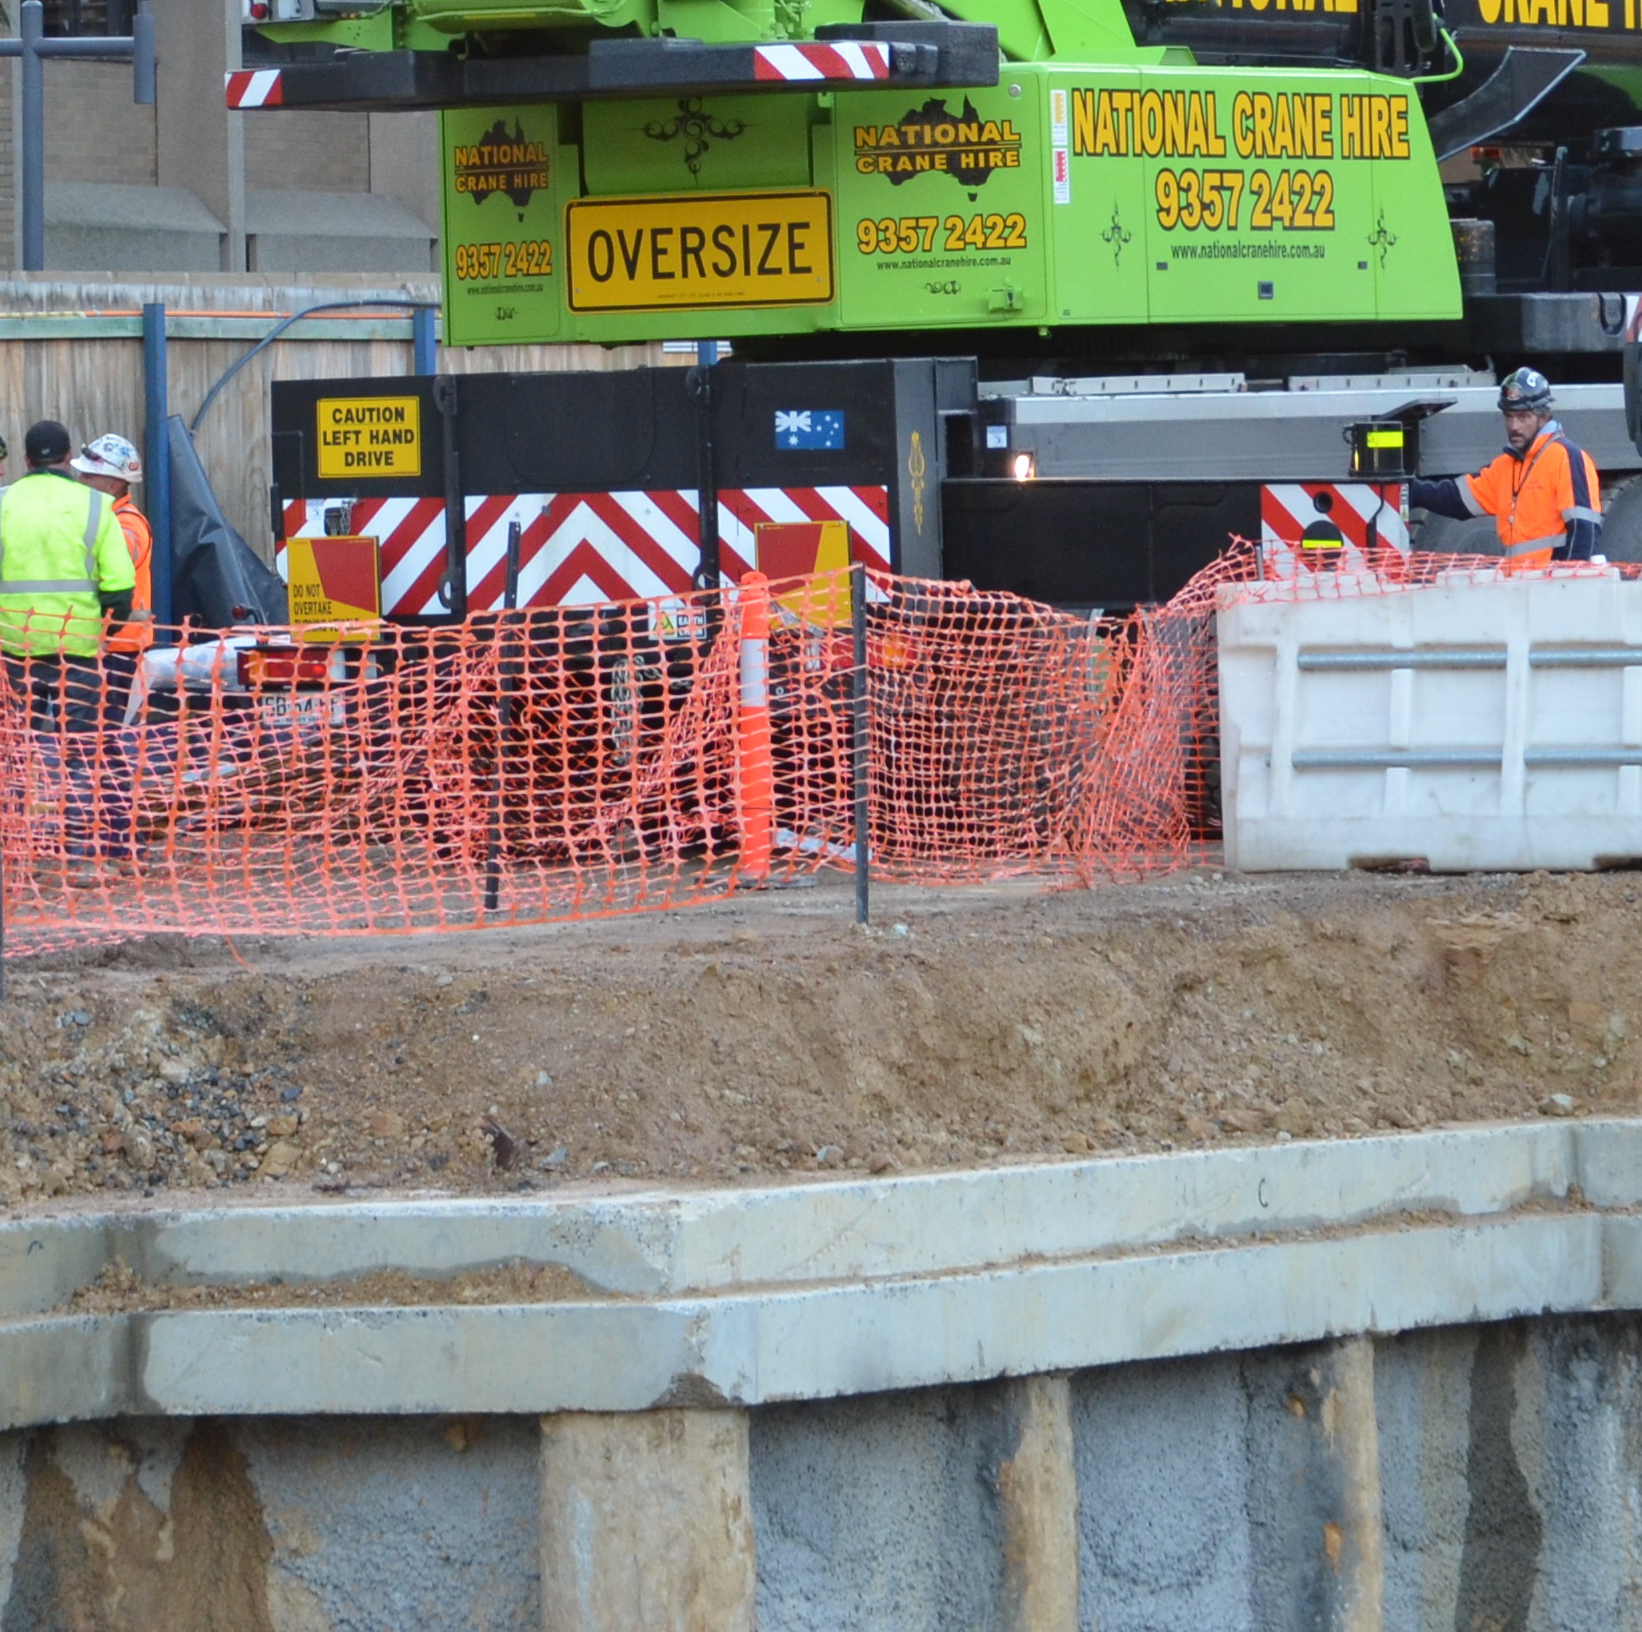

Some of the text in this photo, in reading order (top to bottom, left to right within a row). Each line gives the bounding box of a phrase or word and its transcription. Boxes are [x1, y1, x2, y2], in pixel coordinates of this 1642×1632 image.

[854, 120, 1021, 148] NATIONAL
[1072, 88, 1226, 157] NATIONAL
[1233, 91, 1333, 159] CRANE
[1340, 93, 1410, 159] HIRE
[455, 142, 549, 167] NATIONAL
[856, 149, 1020, 174] CRANE HIRE
[455, 172, 549, 193] CRANE HIRE
[1156, 168, 1335, 231] 9357 2422
[857, 213, 1027, 255] 9357 2422
[456, 240, 552, 280] 9357 2422
[587, 221, 813, 283] OVERSIZE
[1171, 240, 1325, 260] www.nationalcranehire.com.au
[877, 256, 1012, 270] www.nationalcranehire.com.au
[332, 407, 405, 424] CAUTION
[323, 429, 415, 446] LEFT HAND
[344, 451, 394, 467] DRIVE
[293, 583, 320, 598] DO NOT
[293, 601, 333, 616] OVERTAKE
[678, 615, 704, 627] EATH
